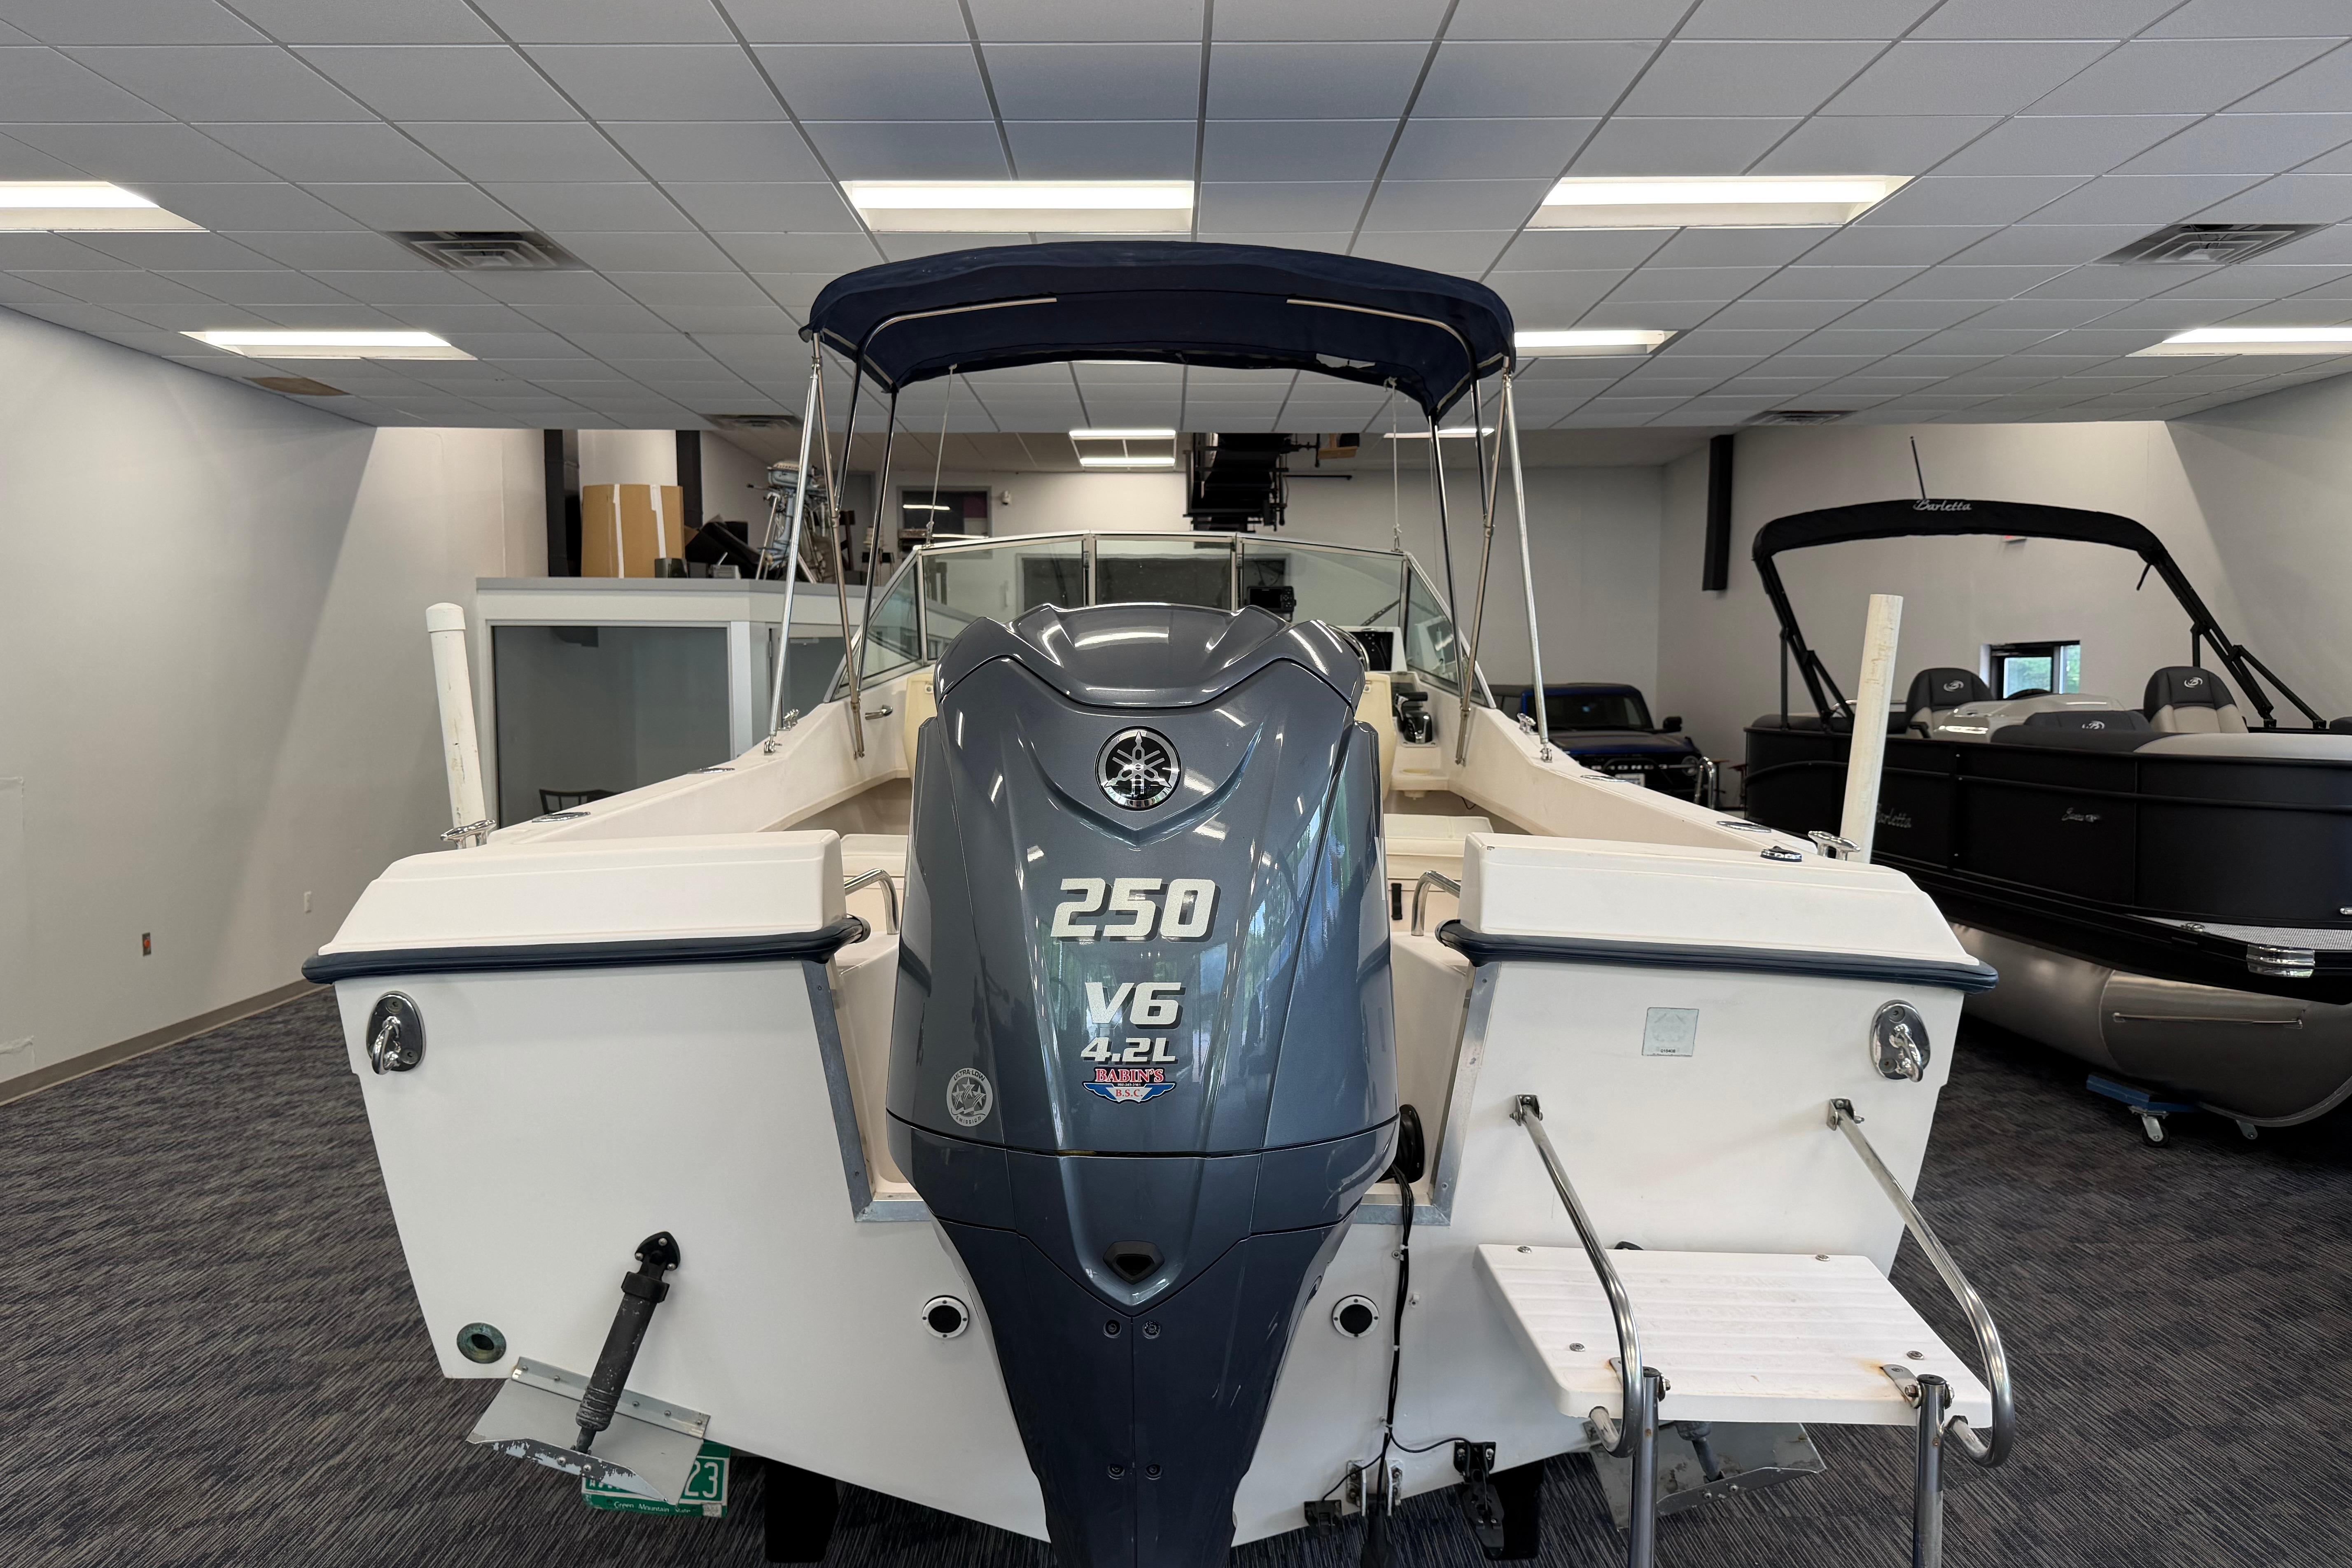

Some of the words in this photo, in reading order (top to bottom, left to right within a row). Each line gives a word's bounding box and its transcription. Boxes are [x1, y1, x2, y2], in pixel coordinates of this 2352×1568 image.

[1913, 499, 1972, 511] Barletta
[1876, 803, 1911, 828] arletta
[1050, 878, 1219, 940] 250
[1085, 982, 1184, 1027] V6
[1080, 1037, 1177, 1063] 4.2L
[953, 1069, 985, 1082] ULTRA-LOW
[1095, 1069, 1164, 1083] BABIN'S
[1115, 1089, 1143, 1097] B.S.C.
[956, 1115, 982, 1124] EMISSION
[638, 1503, 670, 1513] Mountain
